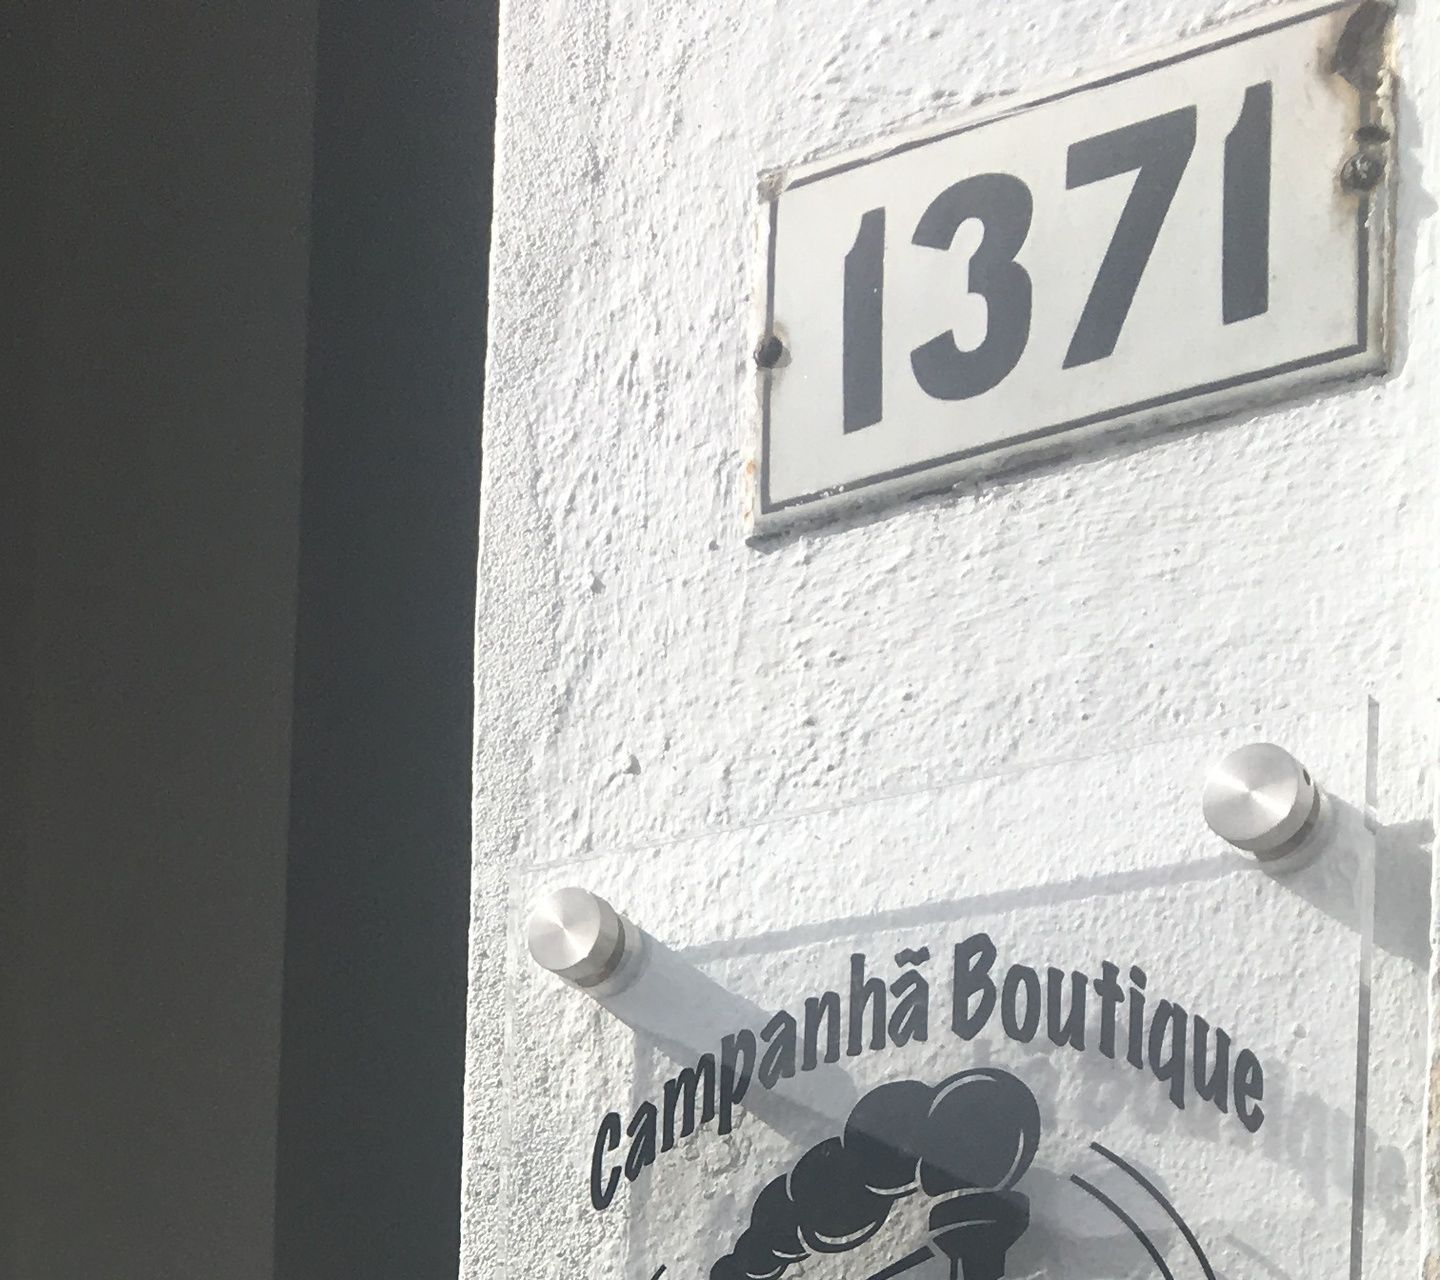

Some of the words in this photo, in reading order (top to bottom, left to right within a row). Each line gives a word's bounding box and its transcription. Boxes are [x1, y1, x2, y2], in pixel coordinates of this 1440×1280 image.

[842, 80, 1273, 436] 1371
[590, 946, 931, 1212] Campanhã
[951, 932, 1265, 1133] Boutique
